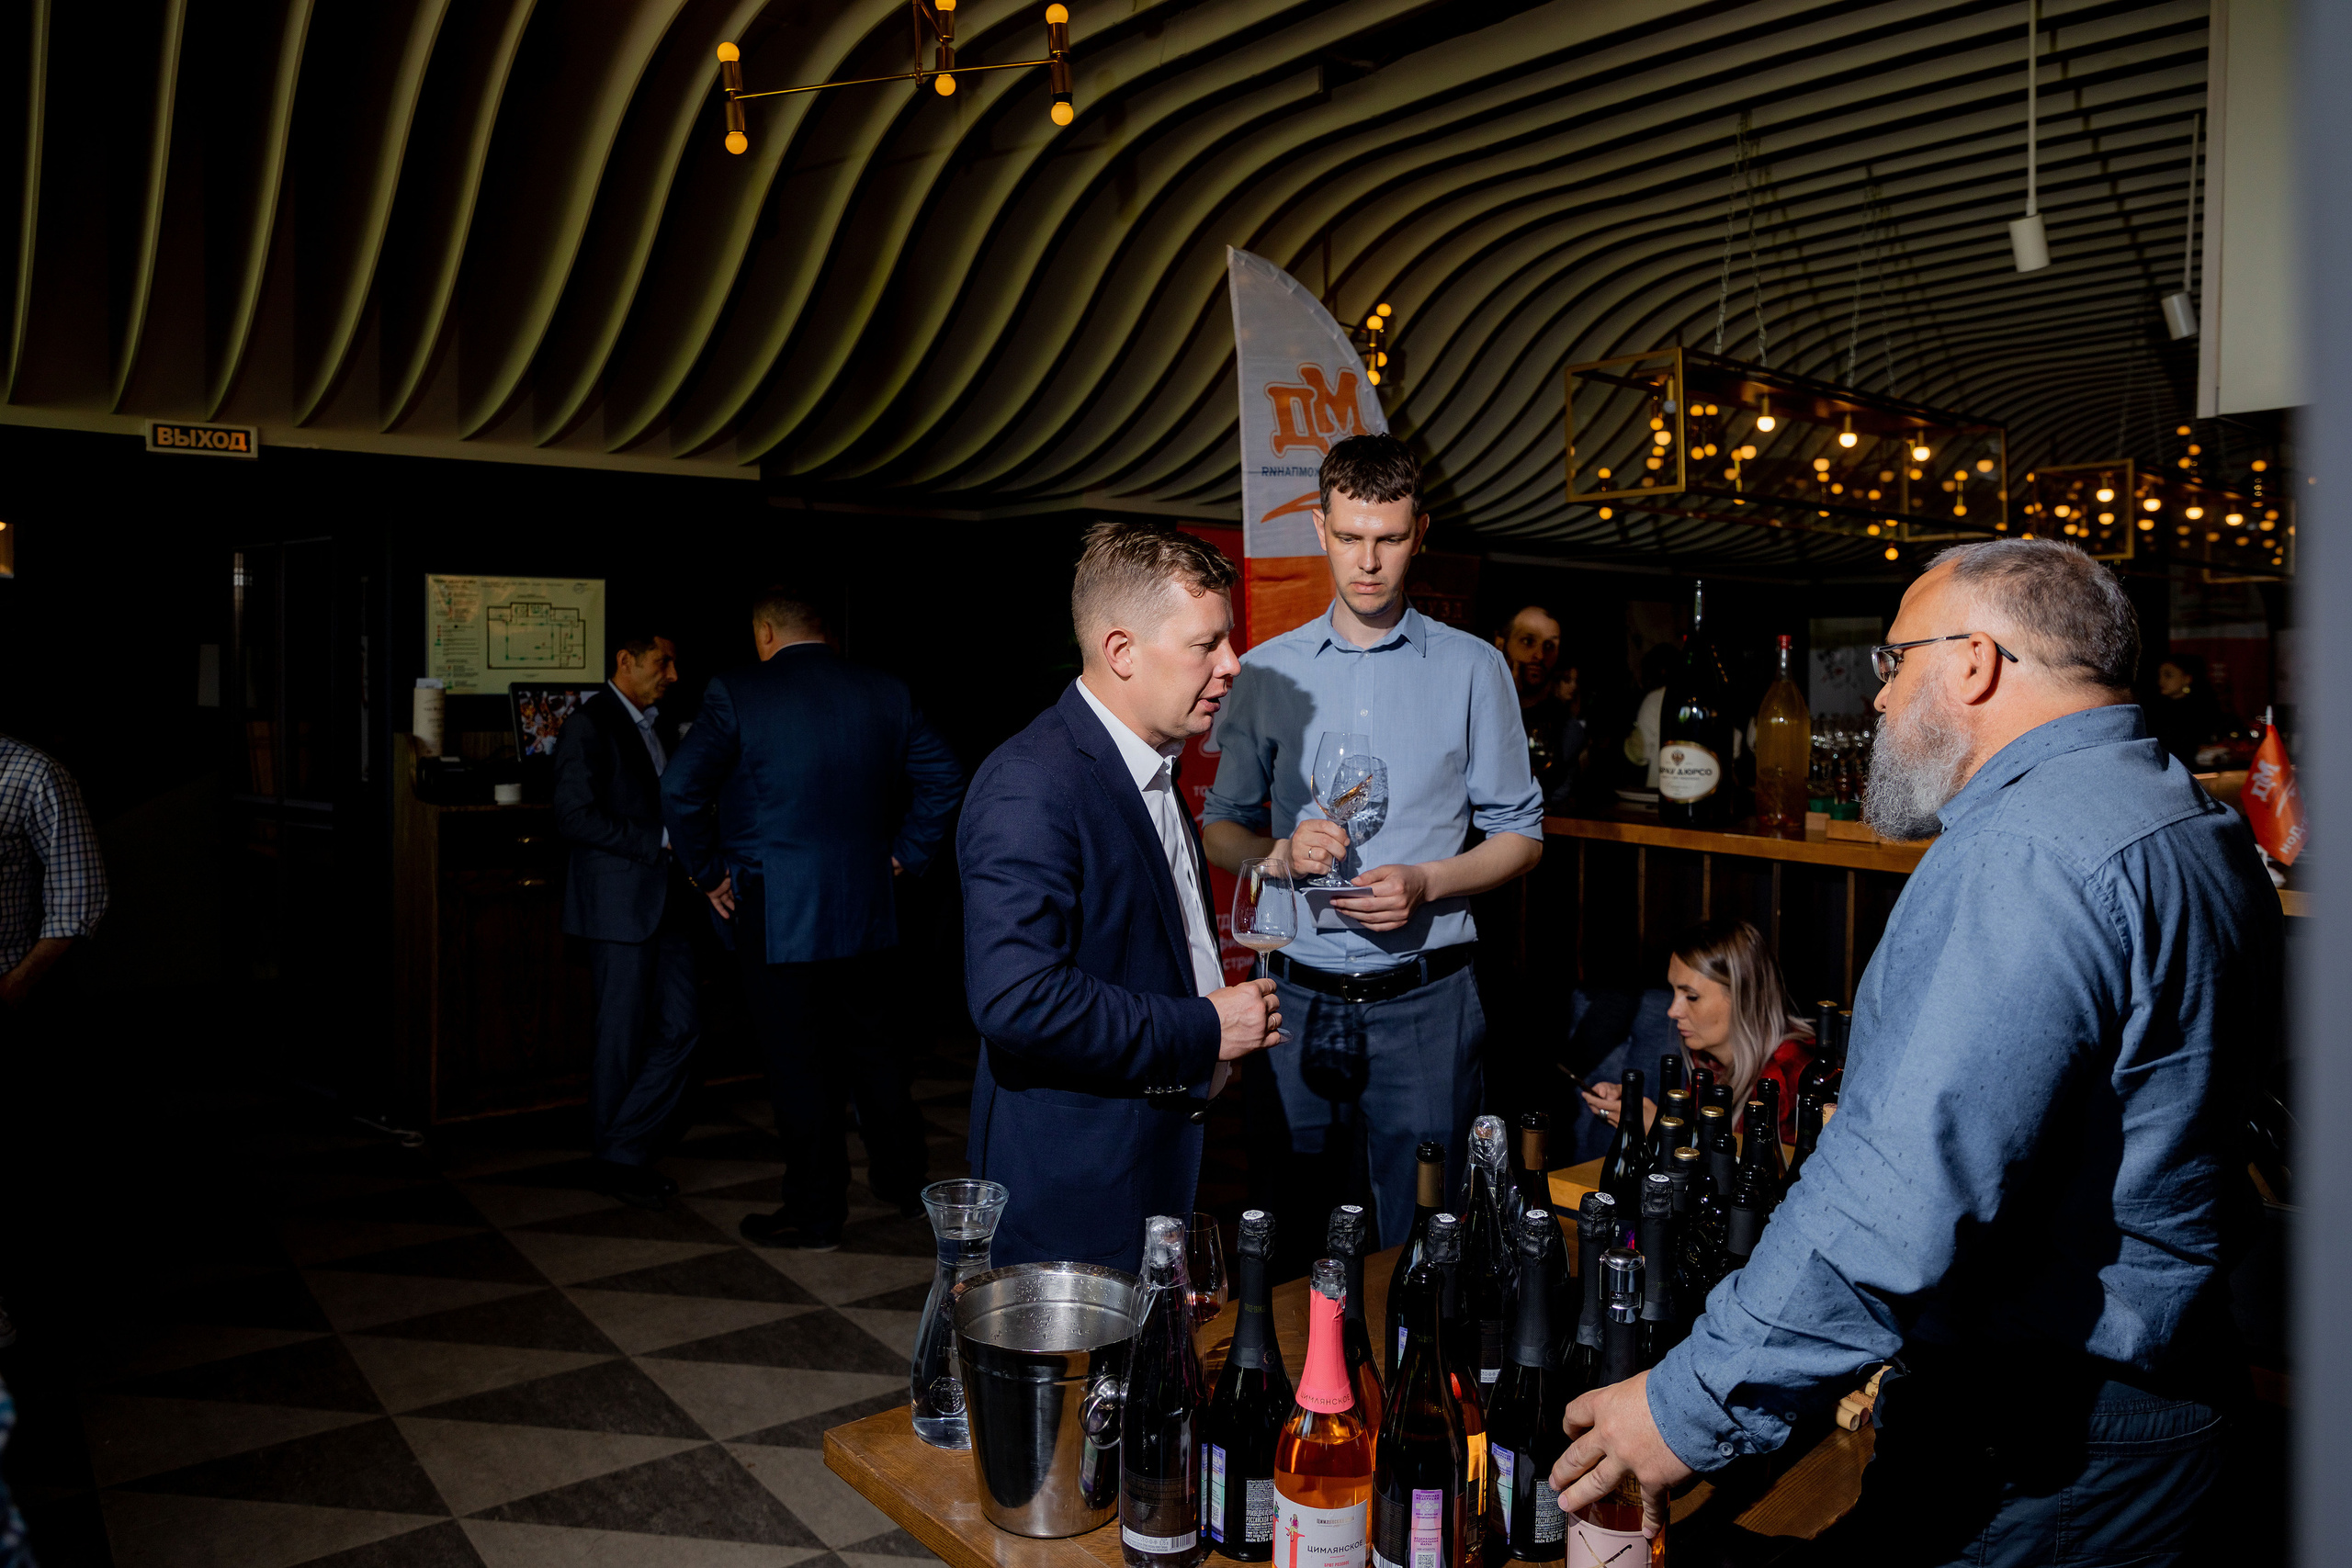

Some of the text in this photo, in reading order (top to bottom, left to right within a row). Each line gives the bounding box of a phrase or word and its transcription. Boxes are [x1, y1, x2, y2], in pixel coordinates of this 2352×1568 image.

[156, 426, 247, 452] ВЫХОД
[1300, 1391, 1351, 1405] ЦИМЛЯНСКОЕ
[1307, 1540, 1363, 1554] ЦИМЛЯНСКОЕ
